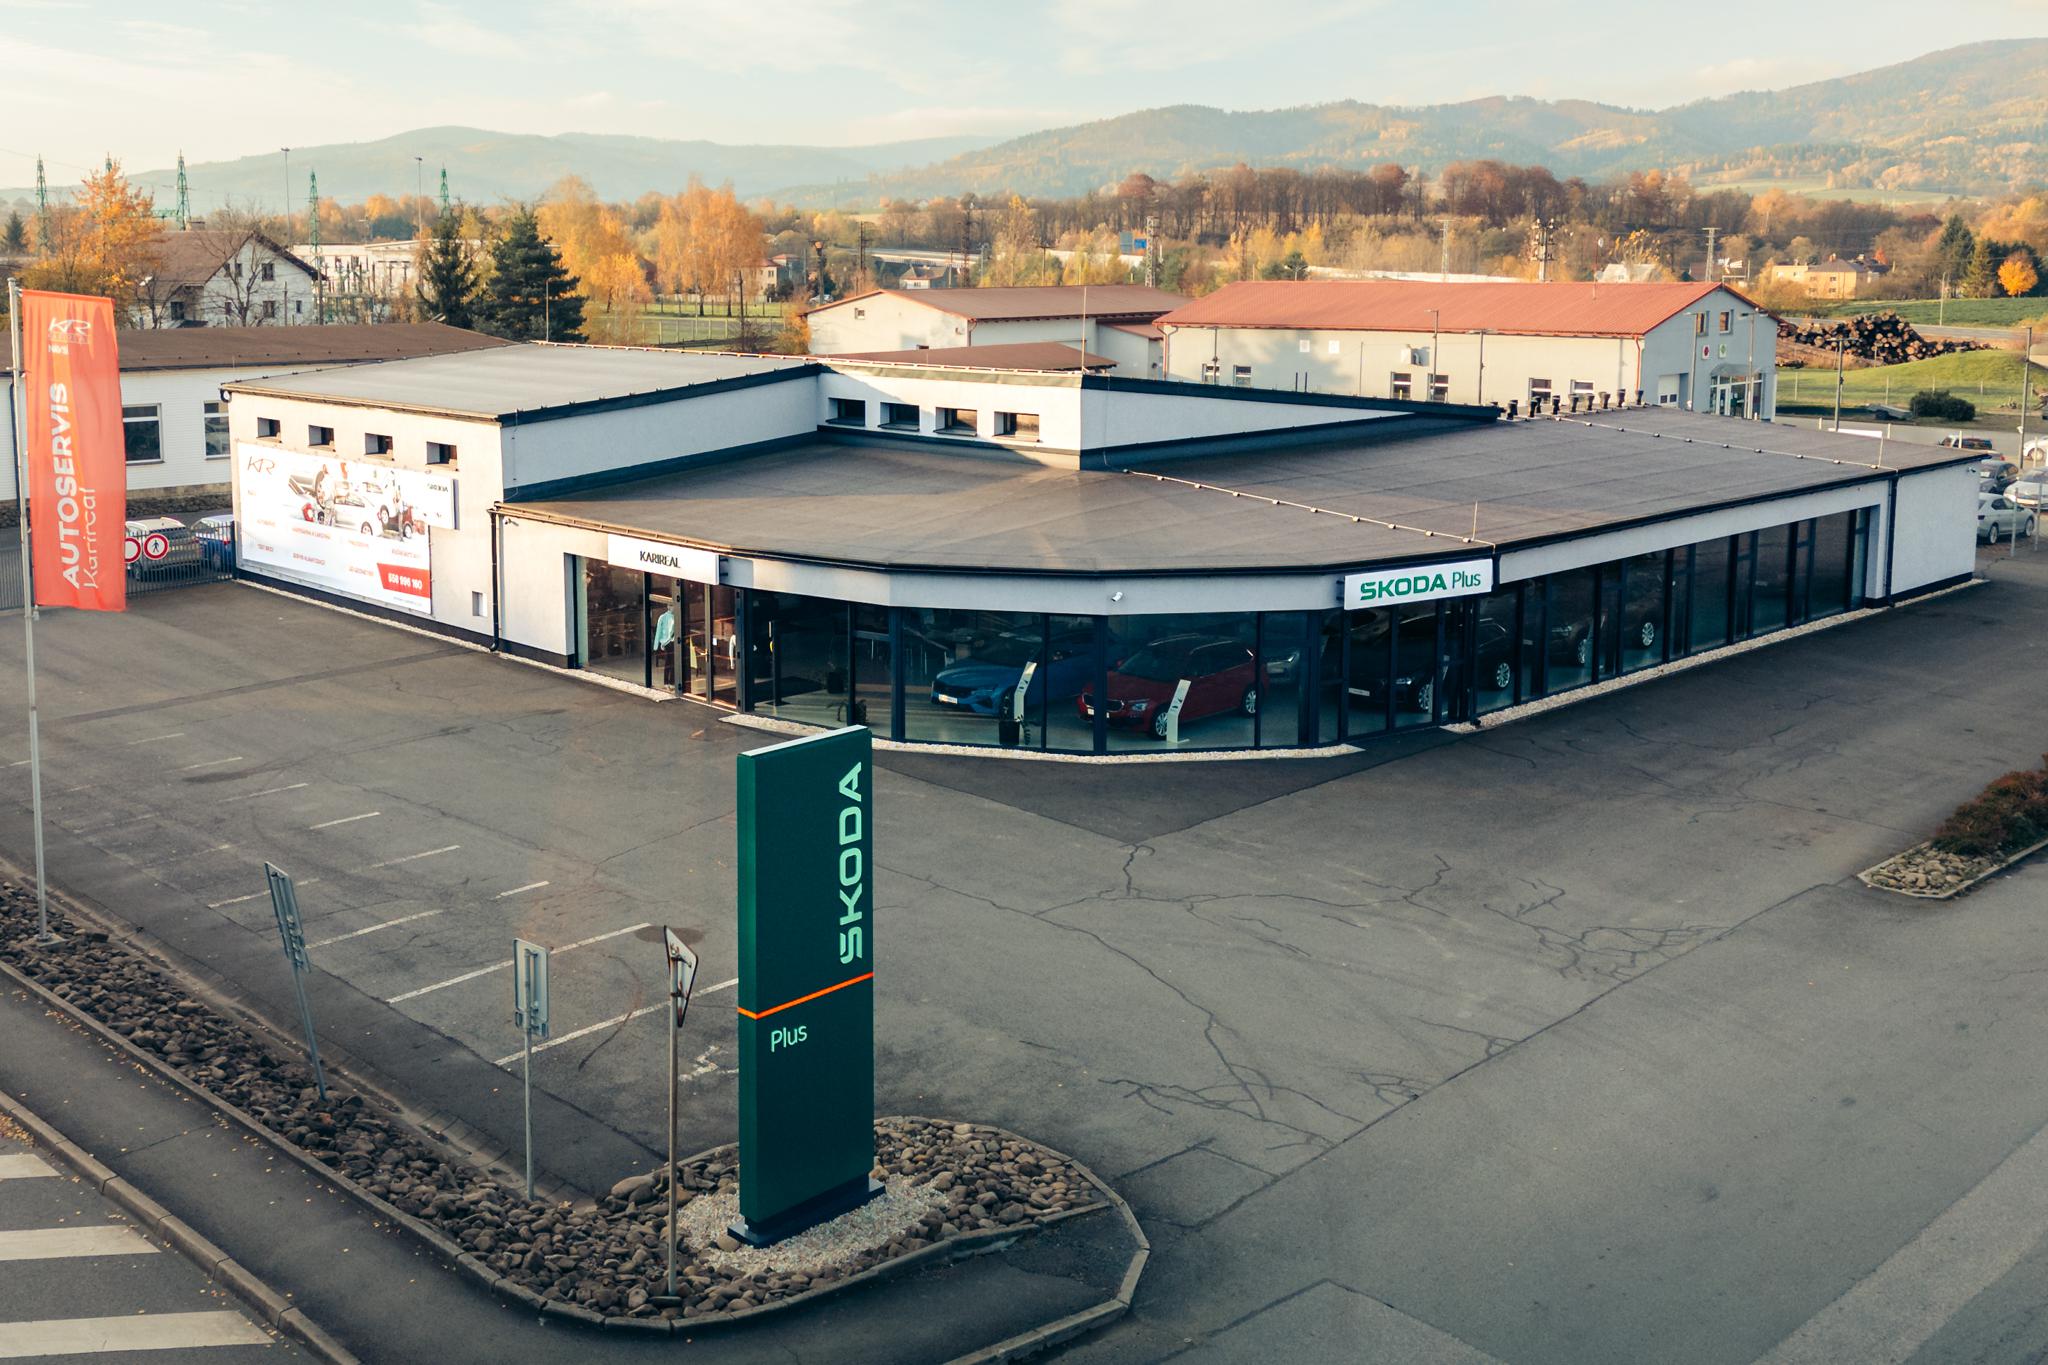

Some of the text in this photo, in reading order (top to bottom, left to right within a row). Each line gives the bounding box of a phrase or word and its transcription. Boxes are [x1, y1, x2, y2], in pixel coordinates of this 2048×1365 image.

[49, 382, 80, 590] AUTOSERVIS
[639, 551, 680, 568] KARIREAL
[1360, 570, 1482, 600] SKODA Plus
[839, 761, 863, 965] SKODA
[771, 1025, 808, 1053] Plus
